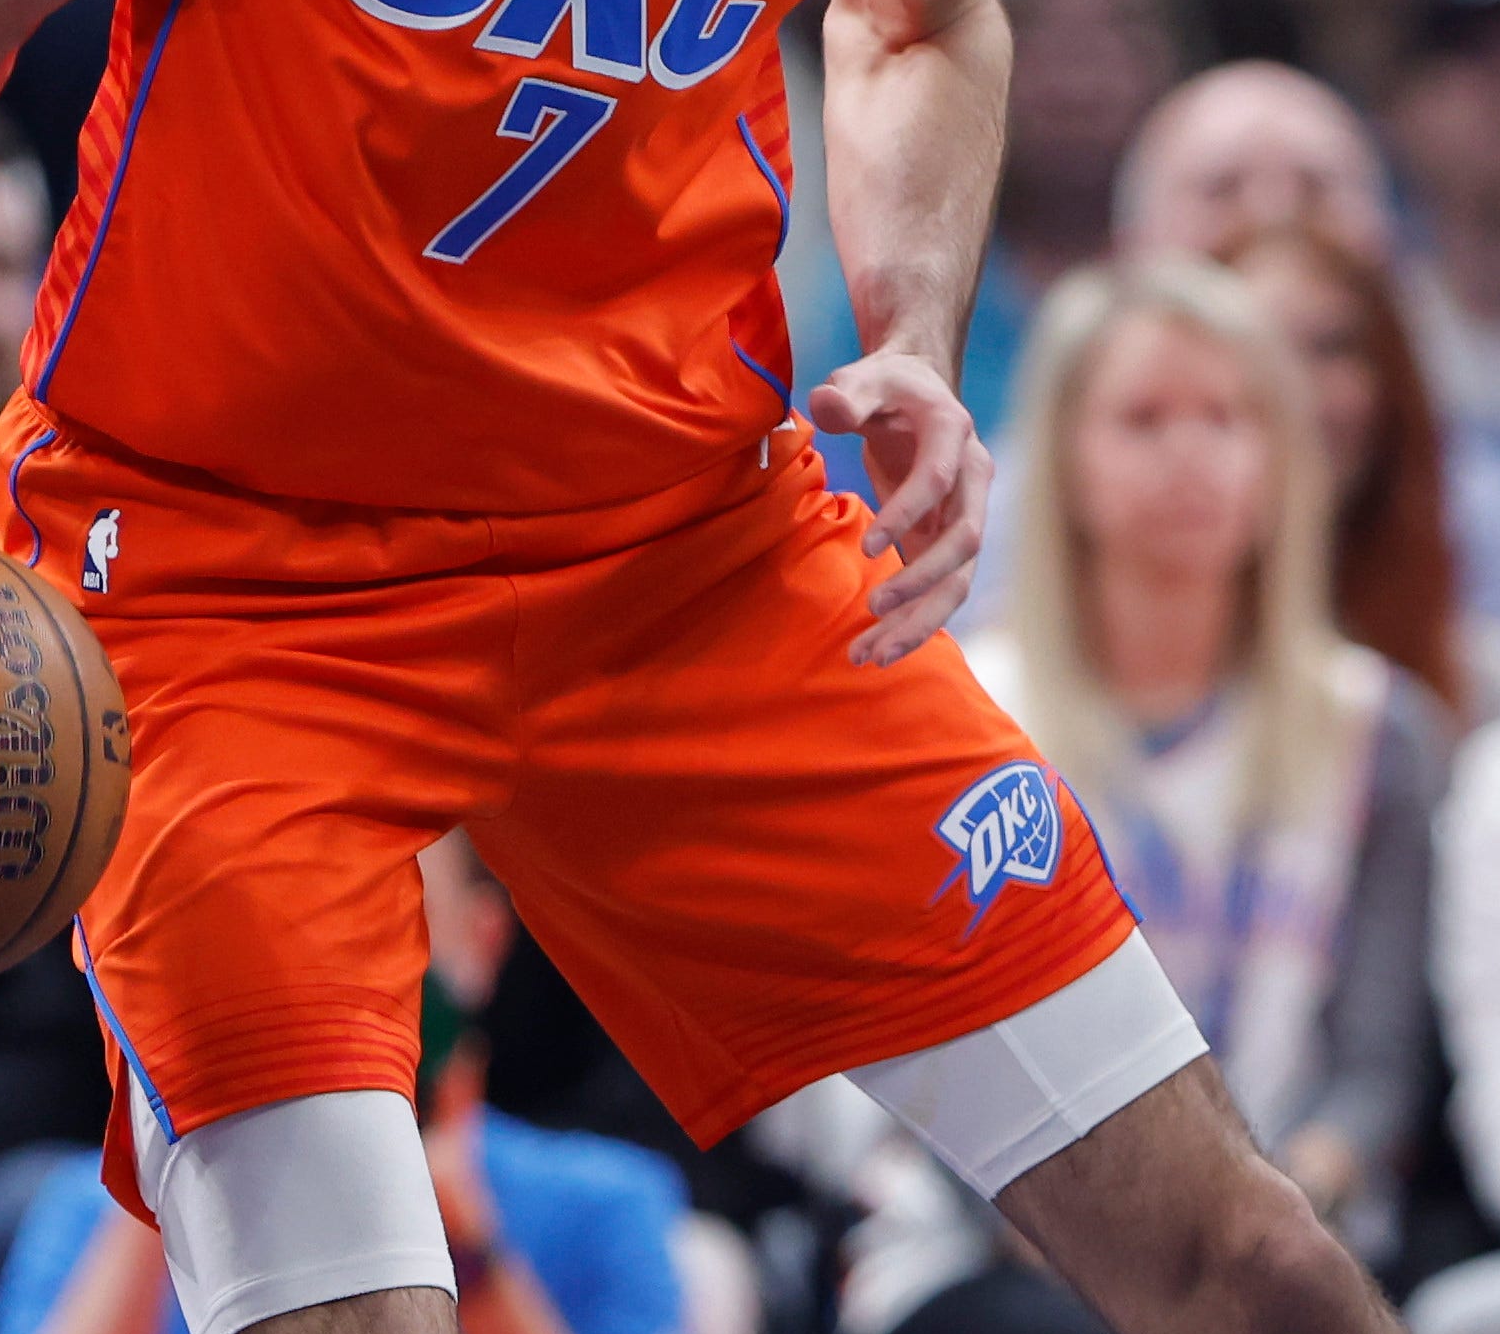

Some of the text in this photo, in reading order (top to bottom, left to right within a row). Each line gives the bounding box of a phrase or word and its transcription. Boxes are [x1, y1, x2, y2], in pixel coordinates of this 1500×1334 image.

[423, 78, 616, 264] 7
[83, 571, 100, 589] NBA
[969, 778, 1038, 896] OKC
